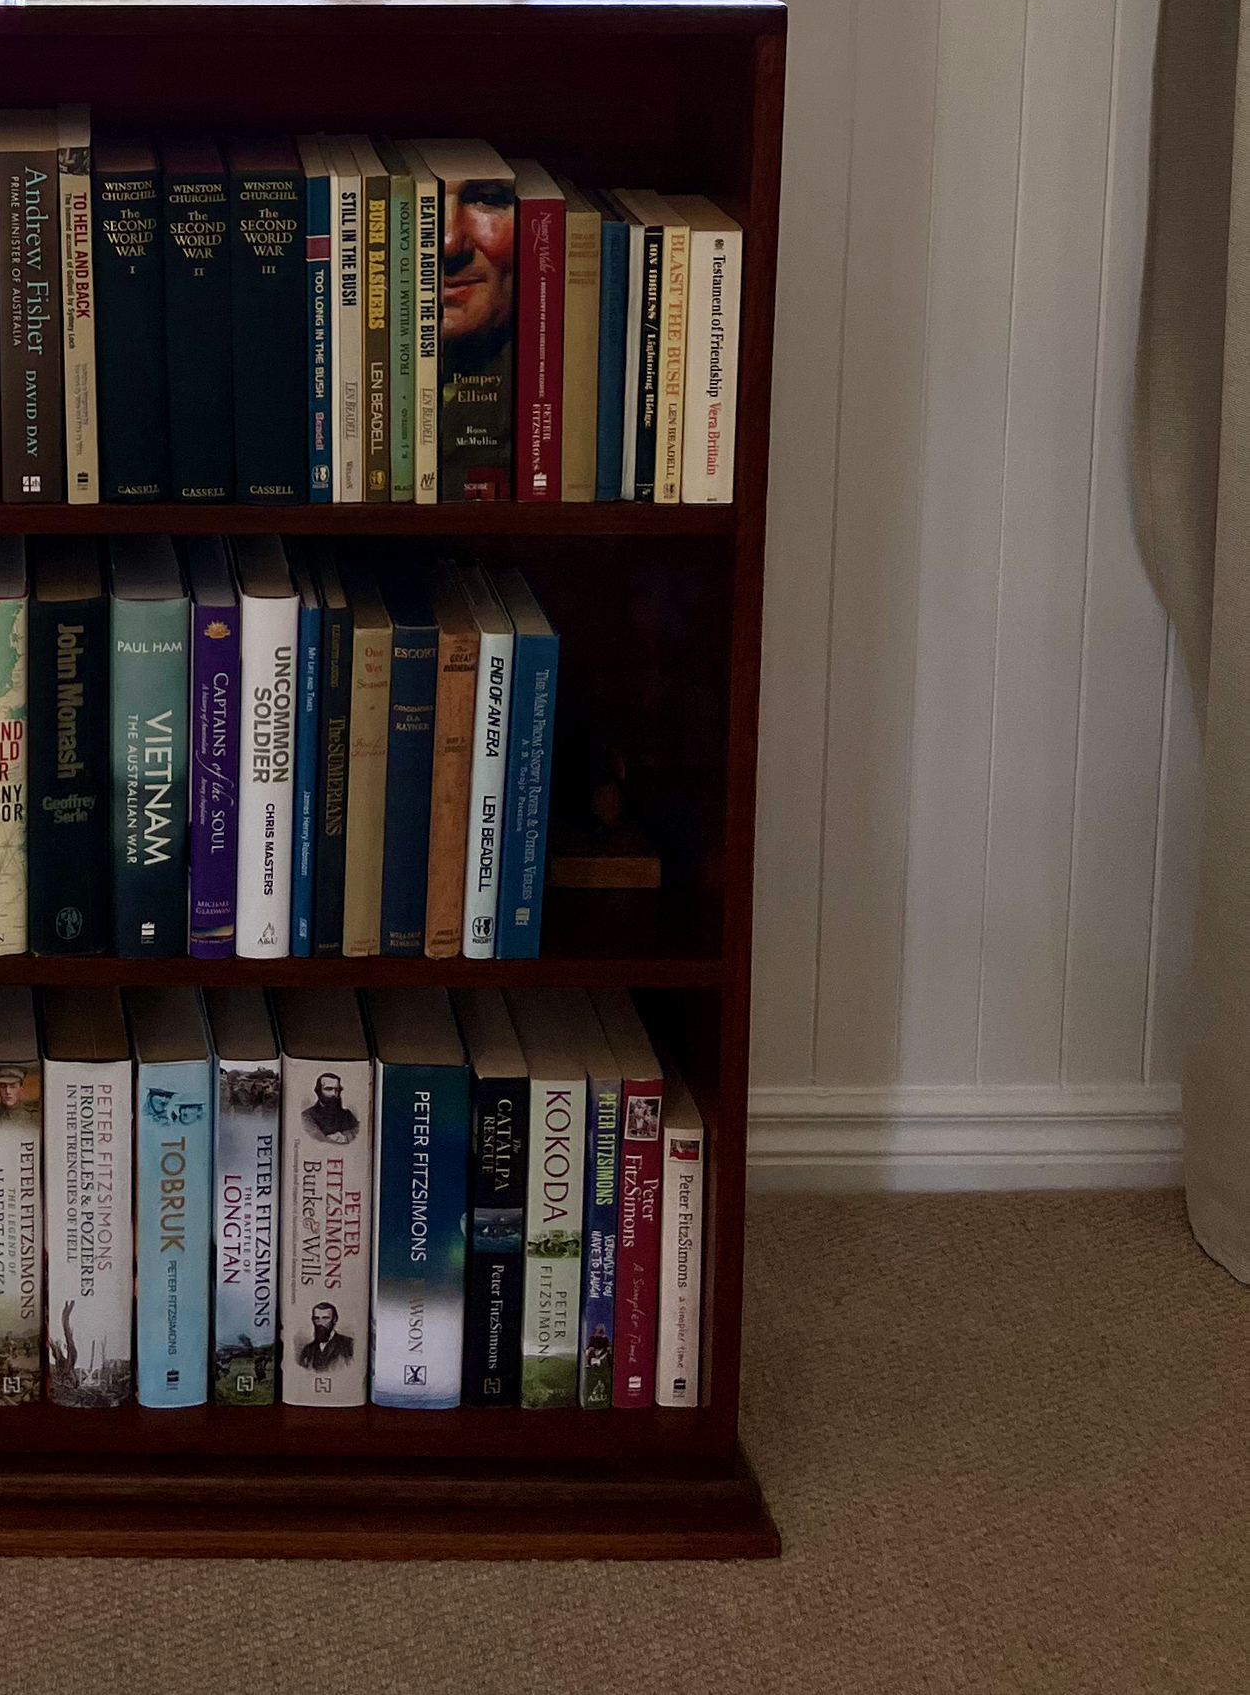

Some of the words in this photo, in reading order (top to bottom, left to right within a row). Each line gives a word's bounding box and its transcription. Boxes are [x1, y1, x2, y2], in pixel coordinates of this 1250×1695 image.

[10, 176, 20, 208] PRIME
[73, 193, 87, 210] TO
[341, 192, 356, 227] STILL
[11, 213, 21, 264] MINISTER
[24, 166, 49, 270] Andrew
[74, 213, 87, 246] HELL
[342, 229, 356, 242] IN
[369, 200, 384, 246] BUSH
[420, 196, 434, 247] BEATING
[11, 268, 21, 283] OF
[75, 251, 89, 278] AND
[342, 247, 356, 269] THE
[421, 252, 435, 293] ABOUT
[669, 234, 685, 295] BLAST
[76, 283, 89, 318] BACK
[341, 274, 357, 306] BUSH
[369, 250, 388, 330] BASHERS
[421, 297, 435, 321] THE
[712, 255, 725, 316] Testament
[12, 288, 22, 346] AUSTRALIA
[26, 281, 50, 355] Fisher
[421, 325, 435, 357] BUSH
[668, 302, 682, 339] THE
[710, 318, 723, 331] of
[370, 361, 383, 389] LEN
[666, 347, 679, 396] BUSH
[706, 333, 724, 397] Friendship
[25, 370, 38, 419] DAVID
[708, 402, 722, 428] Vera
[26, 429, 38, 457] DAY
[370, 393, 383, 455] BEADELL
[707, 431, 720, 475] Brittain
[57, 623, 84, 679] John
[117, 641, 149, 652] PAUL
[153, 642, 183, 651] HAM
[490, 656, 504, 684] END
[273, 646, 291, 783] UNCOMMON
[487, 706, 501, 726] AN
[489, 687, 502, 704] OF
[57, 683, 84, 778] Monash
[127, 715, 138, 739] THE
[253, 687, 271, 783] SOLDIER
[486, 729, 500, 757] ERA
[127, 745, 139, 828] AUSTRALIAN
[143, 710, 172, 866] VIETNAM
[482, 795, 496, 823] LEN
[264, 803, 274, 838] CHRIS
[126, 834, 138, 864] WAR
[263, 842, 274, 895] MASTERS
[479, 827, 494, 892] BEADELL
[97, 1084, 113, 1143] PETER
[413, 1091, 430, 1146] PETER
[19, 1141, 35, 1198] PETER
[256, 1135, 272, 1198] PETER
[481, 1116, 495, 1174] RESCUE
[494, 1099, 512, 1191] CATALPA
[543, 1090, 571, 1222] KOKODA
[98, 1152, 112, 1271] FITZSIMONS
[161, 1137, 185, 1253] TOBRUK
[224, 1175, 241, 1246] LONG
[410, 1152, 429, 1262] FITZSIMONS
[325, 1157, 343, 1289] FITZSIMONS
[344, 1190, 361, 1256] PETER
[20, 1204, 35, 1319] FITZSIMONS
[223, 1246, 241, 1284] TAN
[255, 1204, 272, 1327] FITZSIMONS
[537, 1266, 551, 1364] FITZSIMONS
[554, 1291, 568, 1338] PETER
